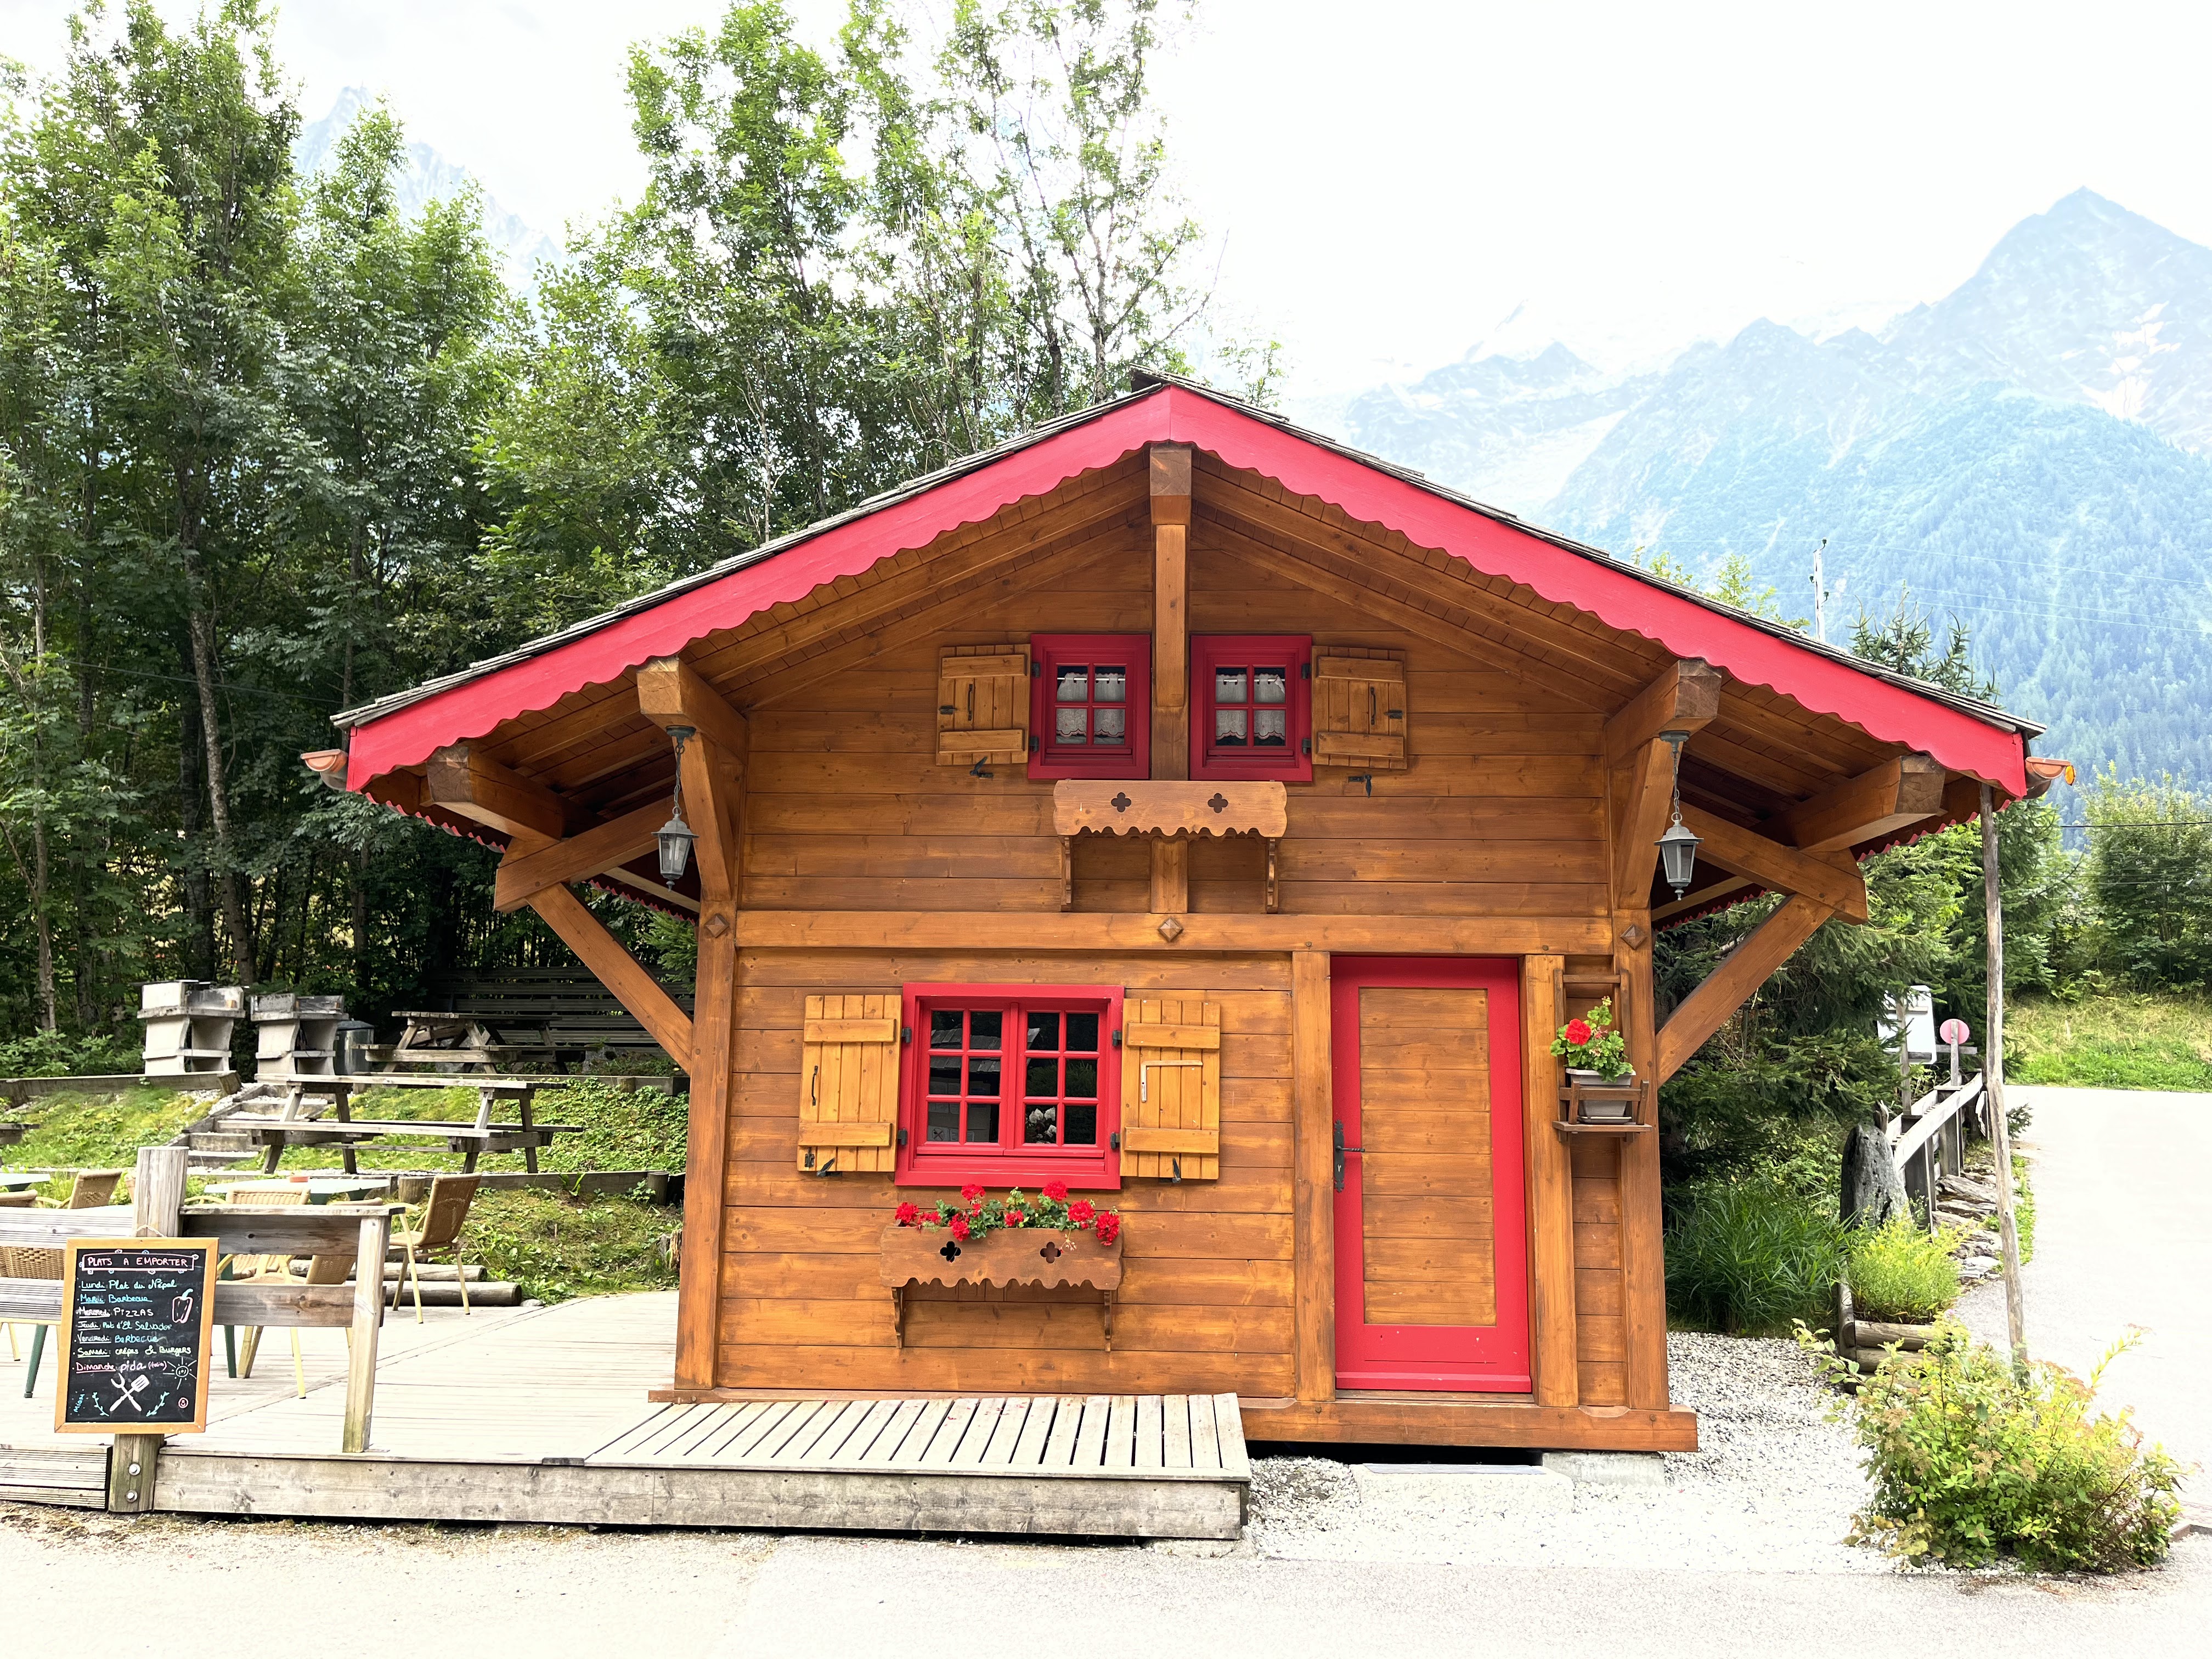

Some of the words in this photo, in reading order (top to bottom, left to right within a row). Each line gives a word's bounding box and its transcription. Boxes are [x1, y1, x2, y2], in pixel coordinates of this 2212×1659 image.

[87, 1257, 113, 1267] PLATS
[123, 1257, 129, 1266] A
[136, 1257, 188, 1267] EMPORTER
[108, 1279, 130, 1290] Plat
[133, 1281, 146, 1289] du
[135, 1321, 172, 1330] Salvador
